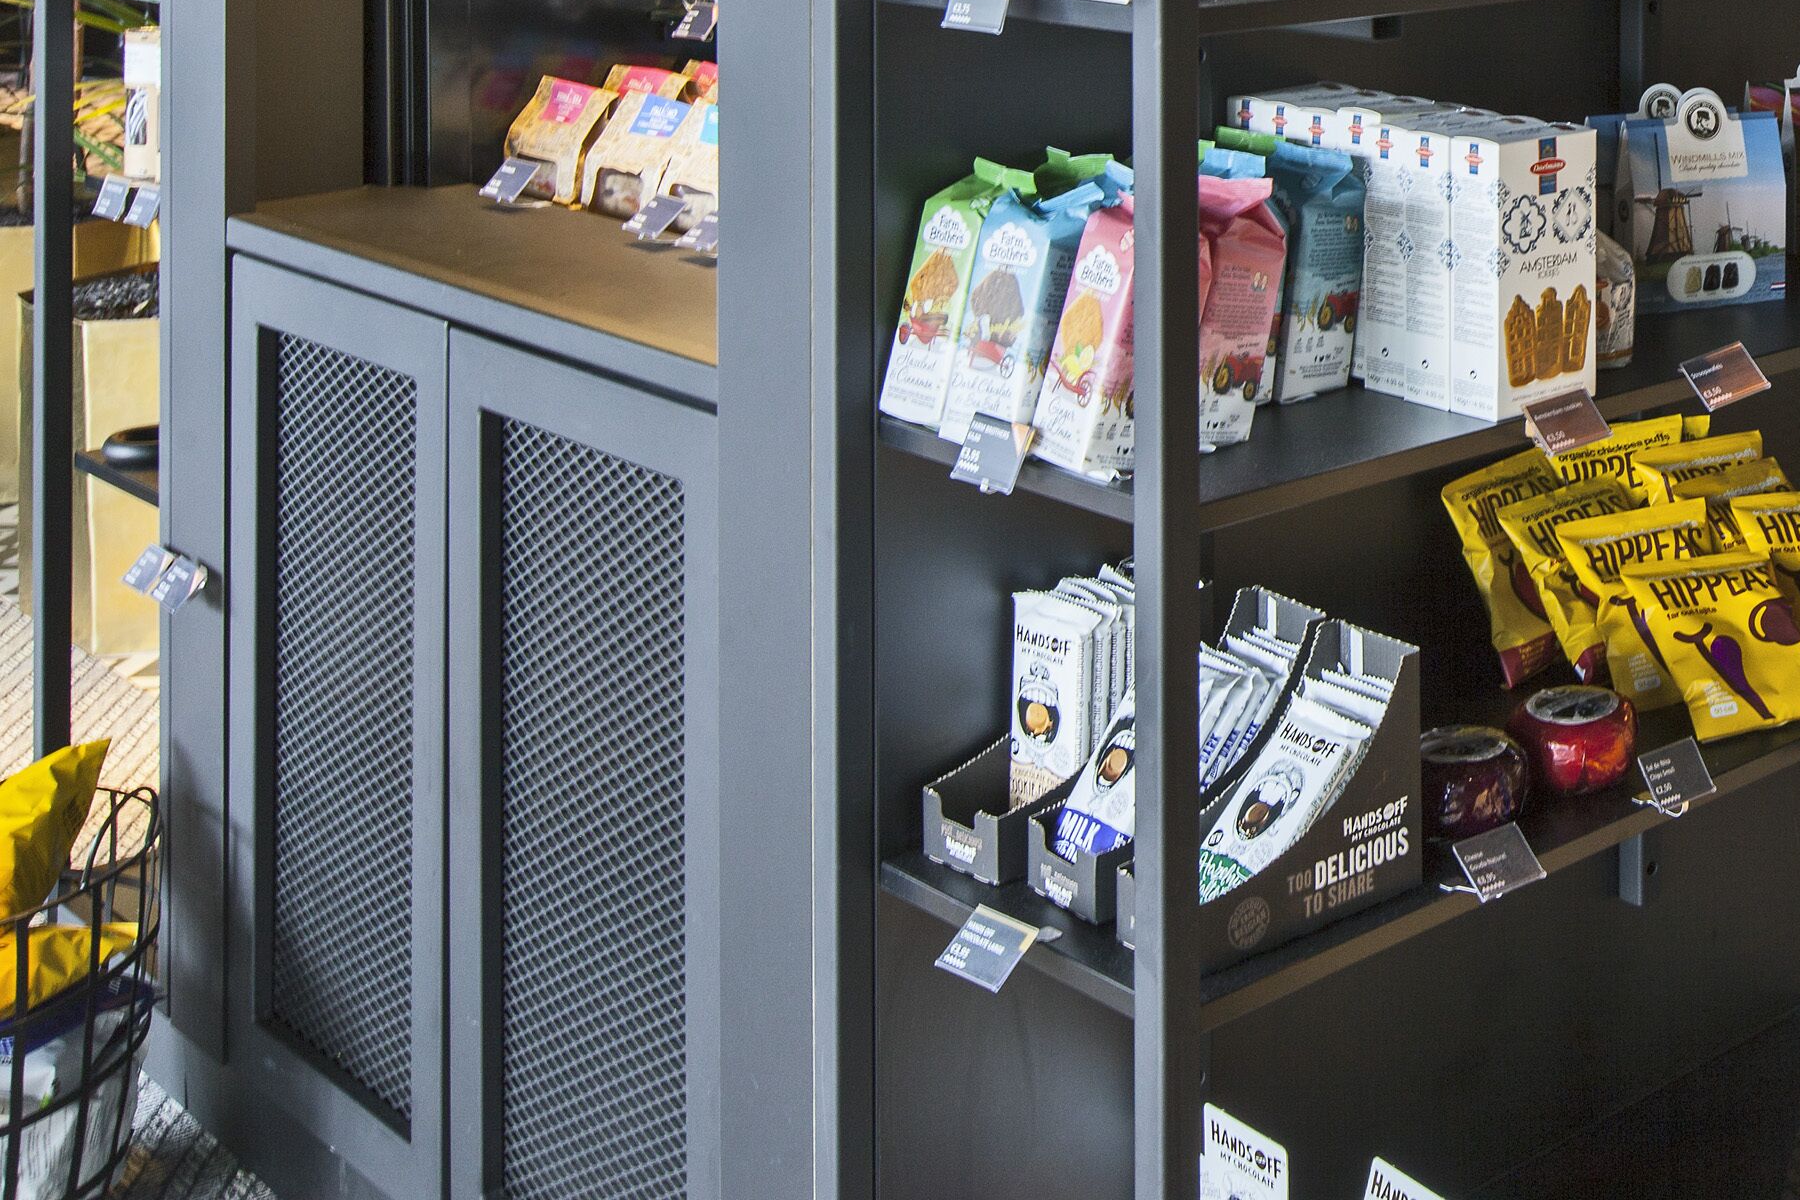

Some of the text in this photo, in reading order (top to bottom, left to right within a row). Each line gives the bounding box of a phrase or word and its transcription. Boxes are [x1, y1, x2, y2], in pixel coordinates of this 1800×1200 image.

[1671, 151, 1745, 165] WINDMILLS MIX
[939, 213, 961, 231] Farm
[930, 226, 964, 246] Brothers
[1001, 230, 1025, 249] Farm
[989, 243, 1029, 266] Brothers
[1092, 253, 1113, 274] Farm
[1519, 252, 1578, 275] AMSTERDAM
[1081, 267, 1115, 289] Brothers
[1558, 432, 1671, 463] organic chickpea puffs
[1649, 563, 1777, 611] HIPPEAS
[1288, 746, 1321, 767] CHOCOLATE
[1057, 810, 1101, 854] MILK
[1351, 815, 1402, 844] MY CHOCOLATE
[1288, 827, 1410, 894] TOO DELICIOUS
[1304, 870, 1375, 919] TO SHARE
[1220, 1151, 1275, 1189] MY CHOCOLATE
